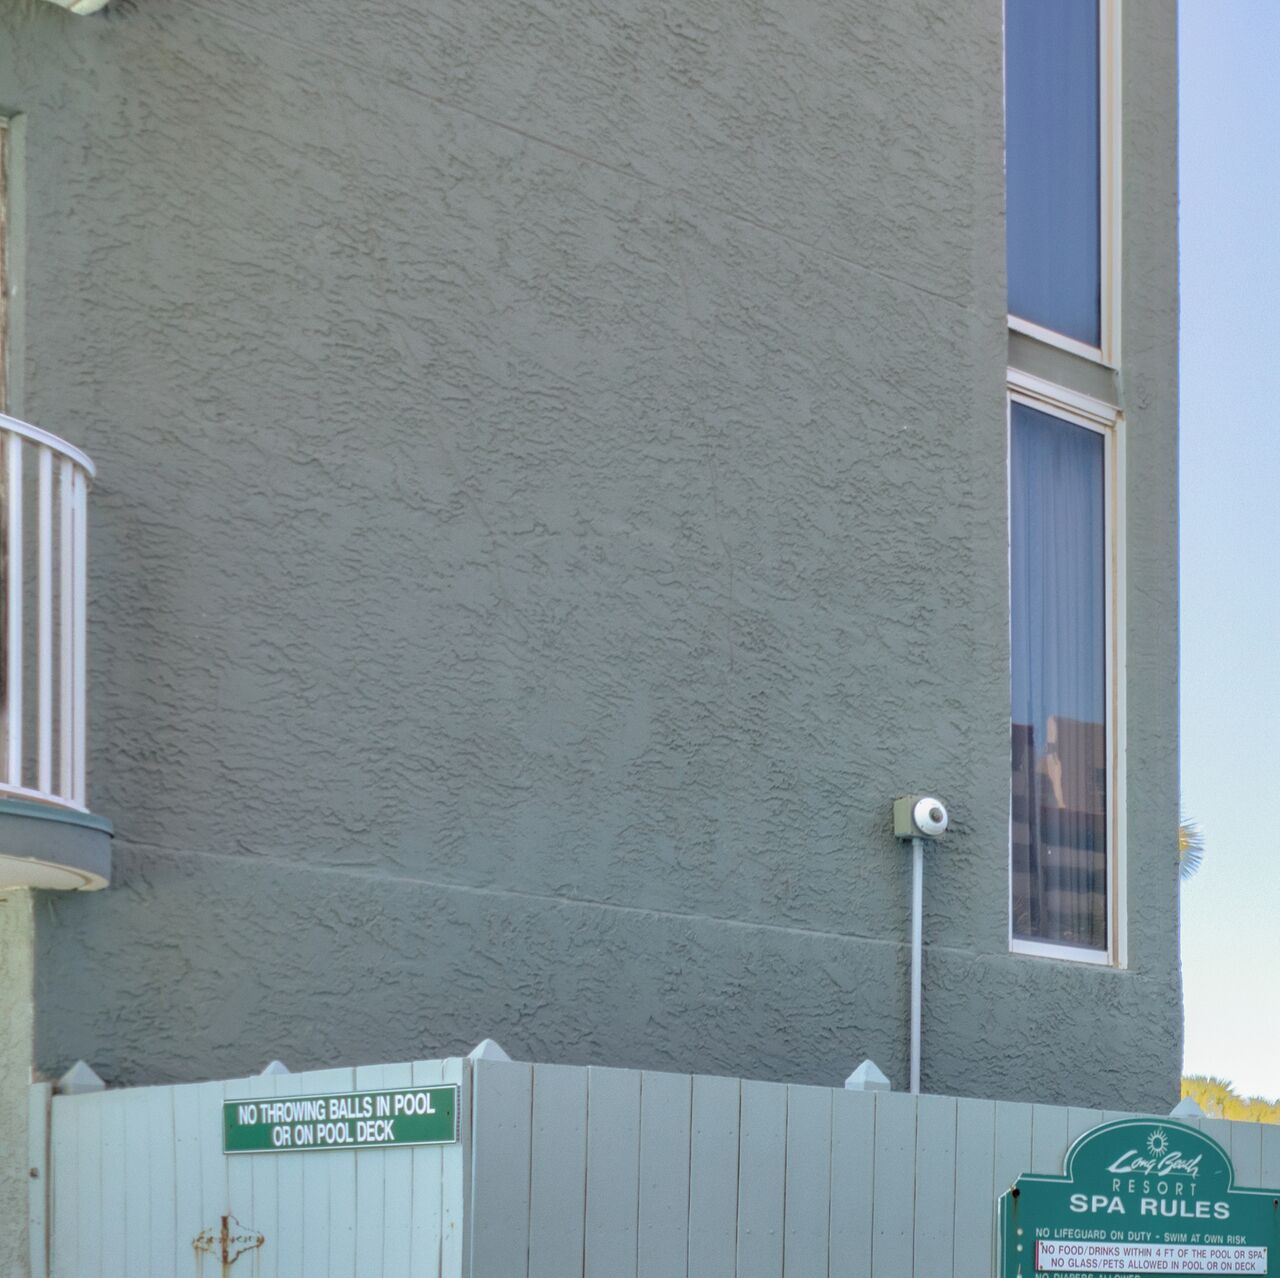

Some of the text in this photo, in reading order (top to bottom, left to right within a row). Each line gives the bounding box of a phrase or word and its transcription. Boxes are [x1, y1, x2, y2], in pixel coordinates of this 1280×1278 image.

[239, 1093, 435, 1125] NO THROWING BALLS IN POOL
[273, 1120, 394, 1146] OR ON POOL DECK
[1107, 1150, 1202, 1180] Long Beach
[1113, 1178, 1196, 1196] RESORT
[1070, 1194, 1230, 1219] SPA RULES
[1036, 1228, 1049, 1237] NO
[1054, 1229, 1106, 1239] LIFEGUARD
[1111, 1230, 1124, 1240] ON
[1128, 1231, 1151, 1241] DUTY
[1164, 1233, 1186, 1242] SWIM
[1191, 1234, 1202, 1243] AT
[1205, 1234, 1223, 1244] OWN
[1227, 1235, 1246, 1244] RISK
[1042, 1244, 1055, 1254] NO
[1059, 1245, 1120, 1256] FOOD/DRINKS
[1123, 1247, 1152, 1257] WITHIN
[1156, 1248, 1160, 1257] 4
[1164, 1248, 1174, 1257] FT
[1178, 1249, 1188, 1258] OF
[1192, 1249, 1206, 1258] THE
[1211, 1250, 1231, 1259] POOL
[1234, 1250, 1246, 1259] OR
[1051, 1258, 1256, 1271] NO GLASS/PETS ALLOWED IN POOL OR ON DECK
